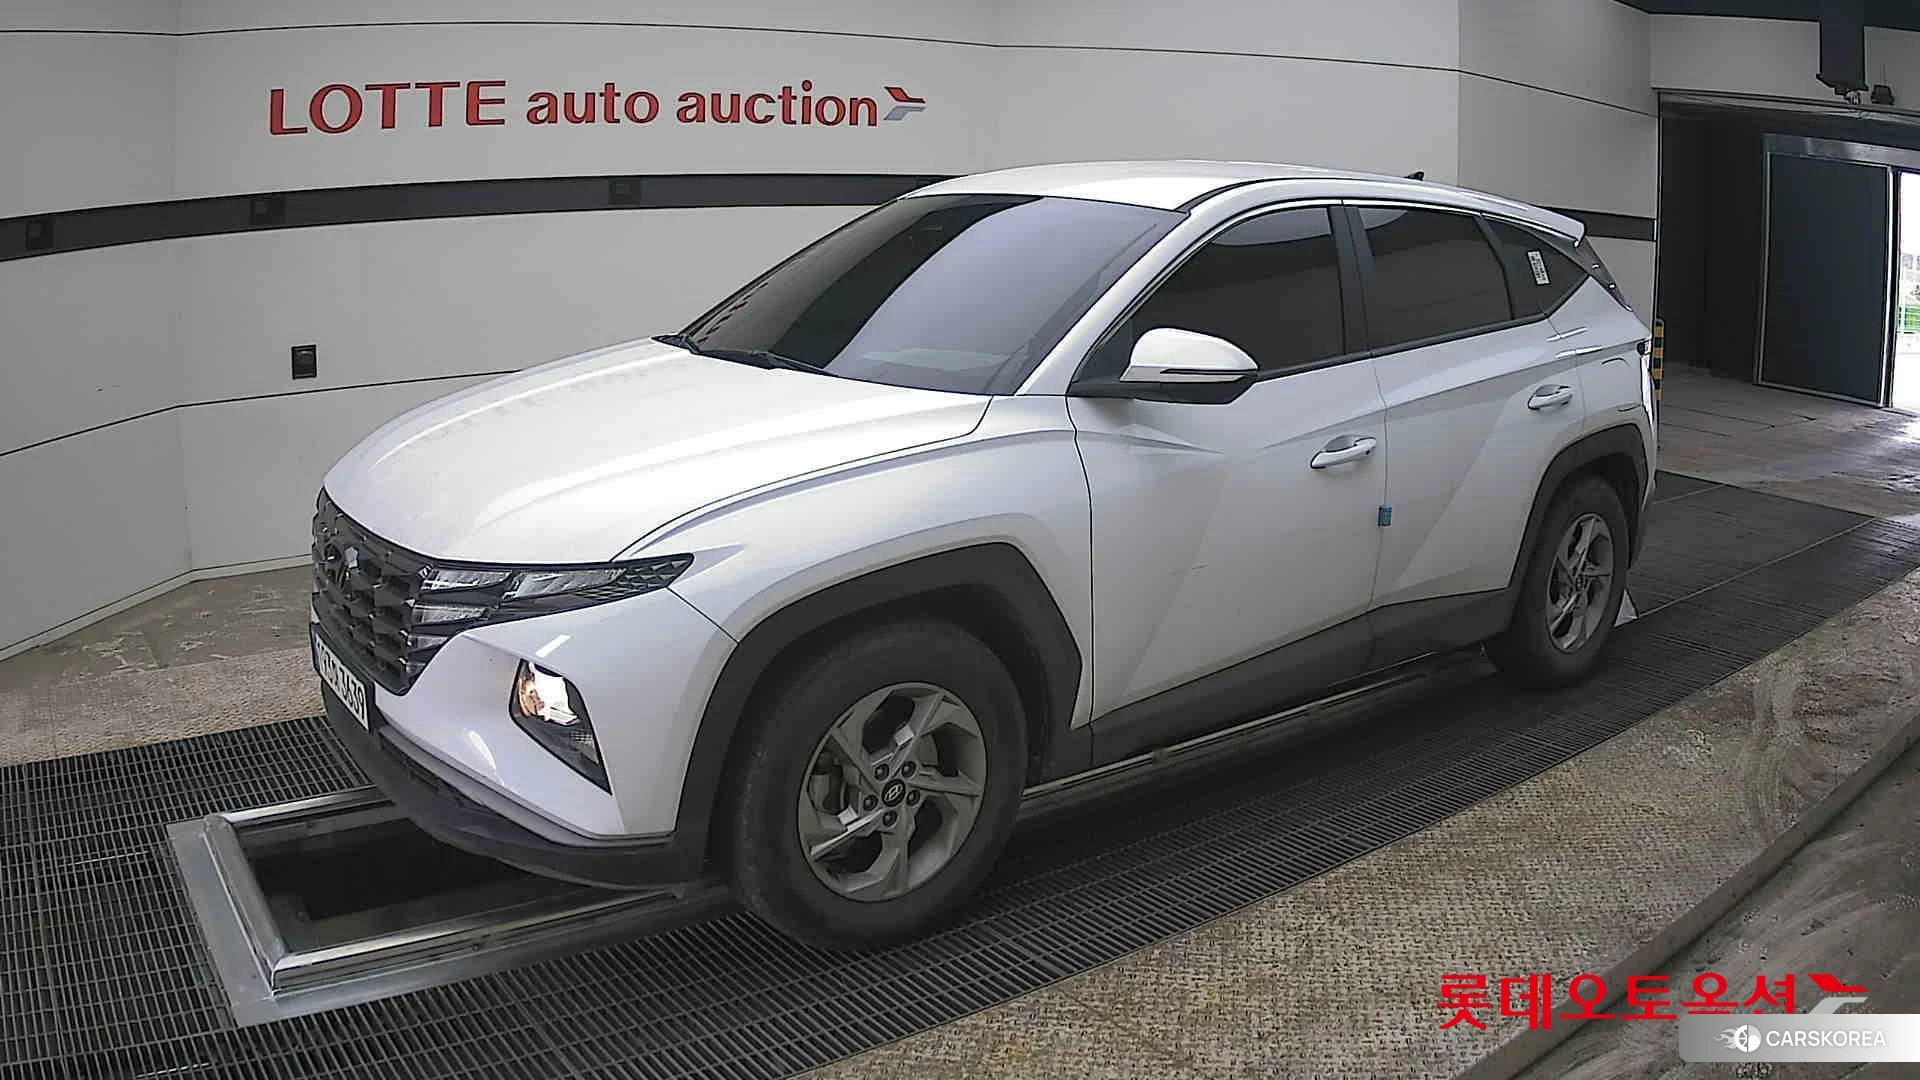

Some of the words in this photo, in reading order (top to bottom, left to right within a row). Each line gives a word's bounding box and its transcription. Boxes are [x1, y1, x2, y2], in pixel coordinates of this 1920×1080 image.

[269, 81, 505, 135] LOTTE
[526, 82, 659, 125] auto
[676, 80, 877, 126] auction
